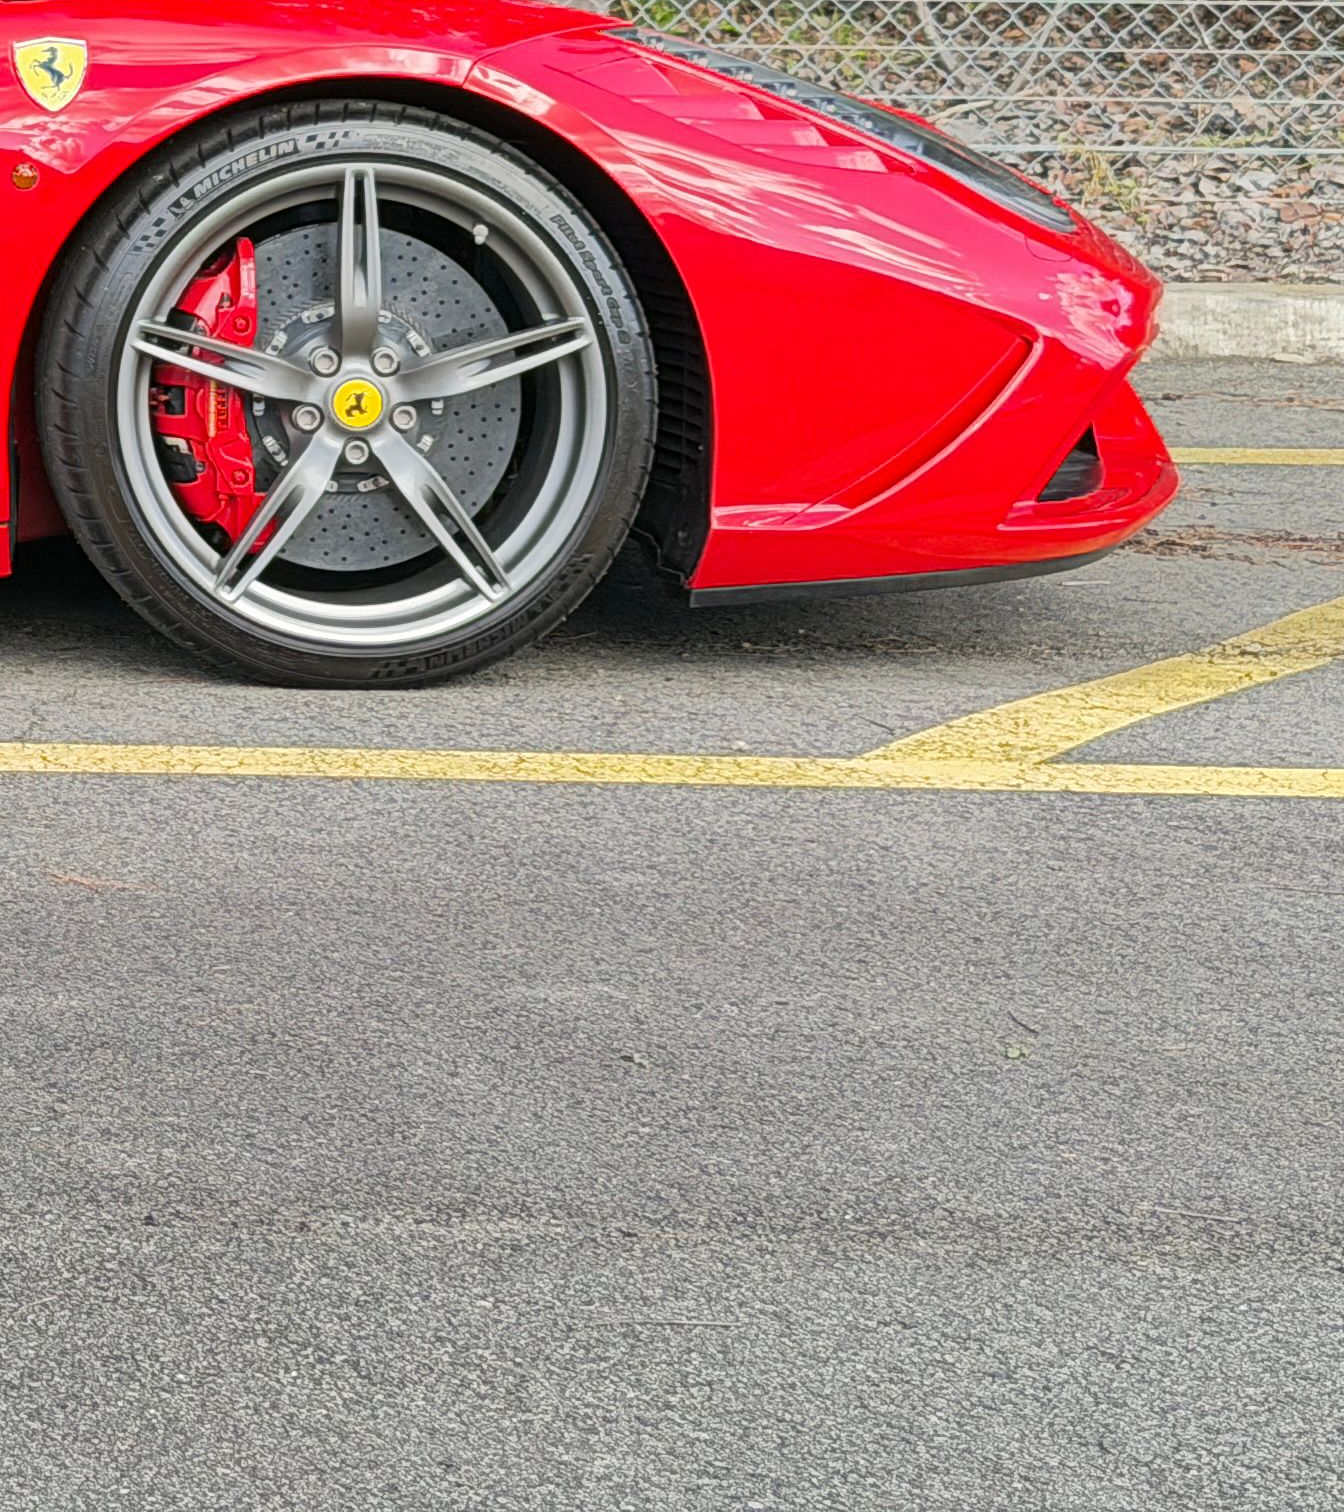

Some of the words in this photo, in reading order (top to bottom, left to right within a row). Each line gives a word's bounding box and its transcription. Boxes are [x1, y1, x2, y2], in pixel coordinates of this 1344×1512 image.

[193, 139, 295, 199] MICHELIN
[549, 213, 586, 251] Pilot
[579, 250, 614, 296] Sport
[606, 297, 624, 329] Cup
